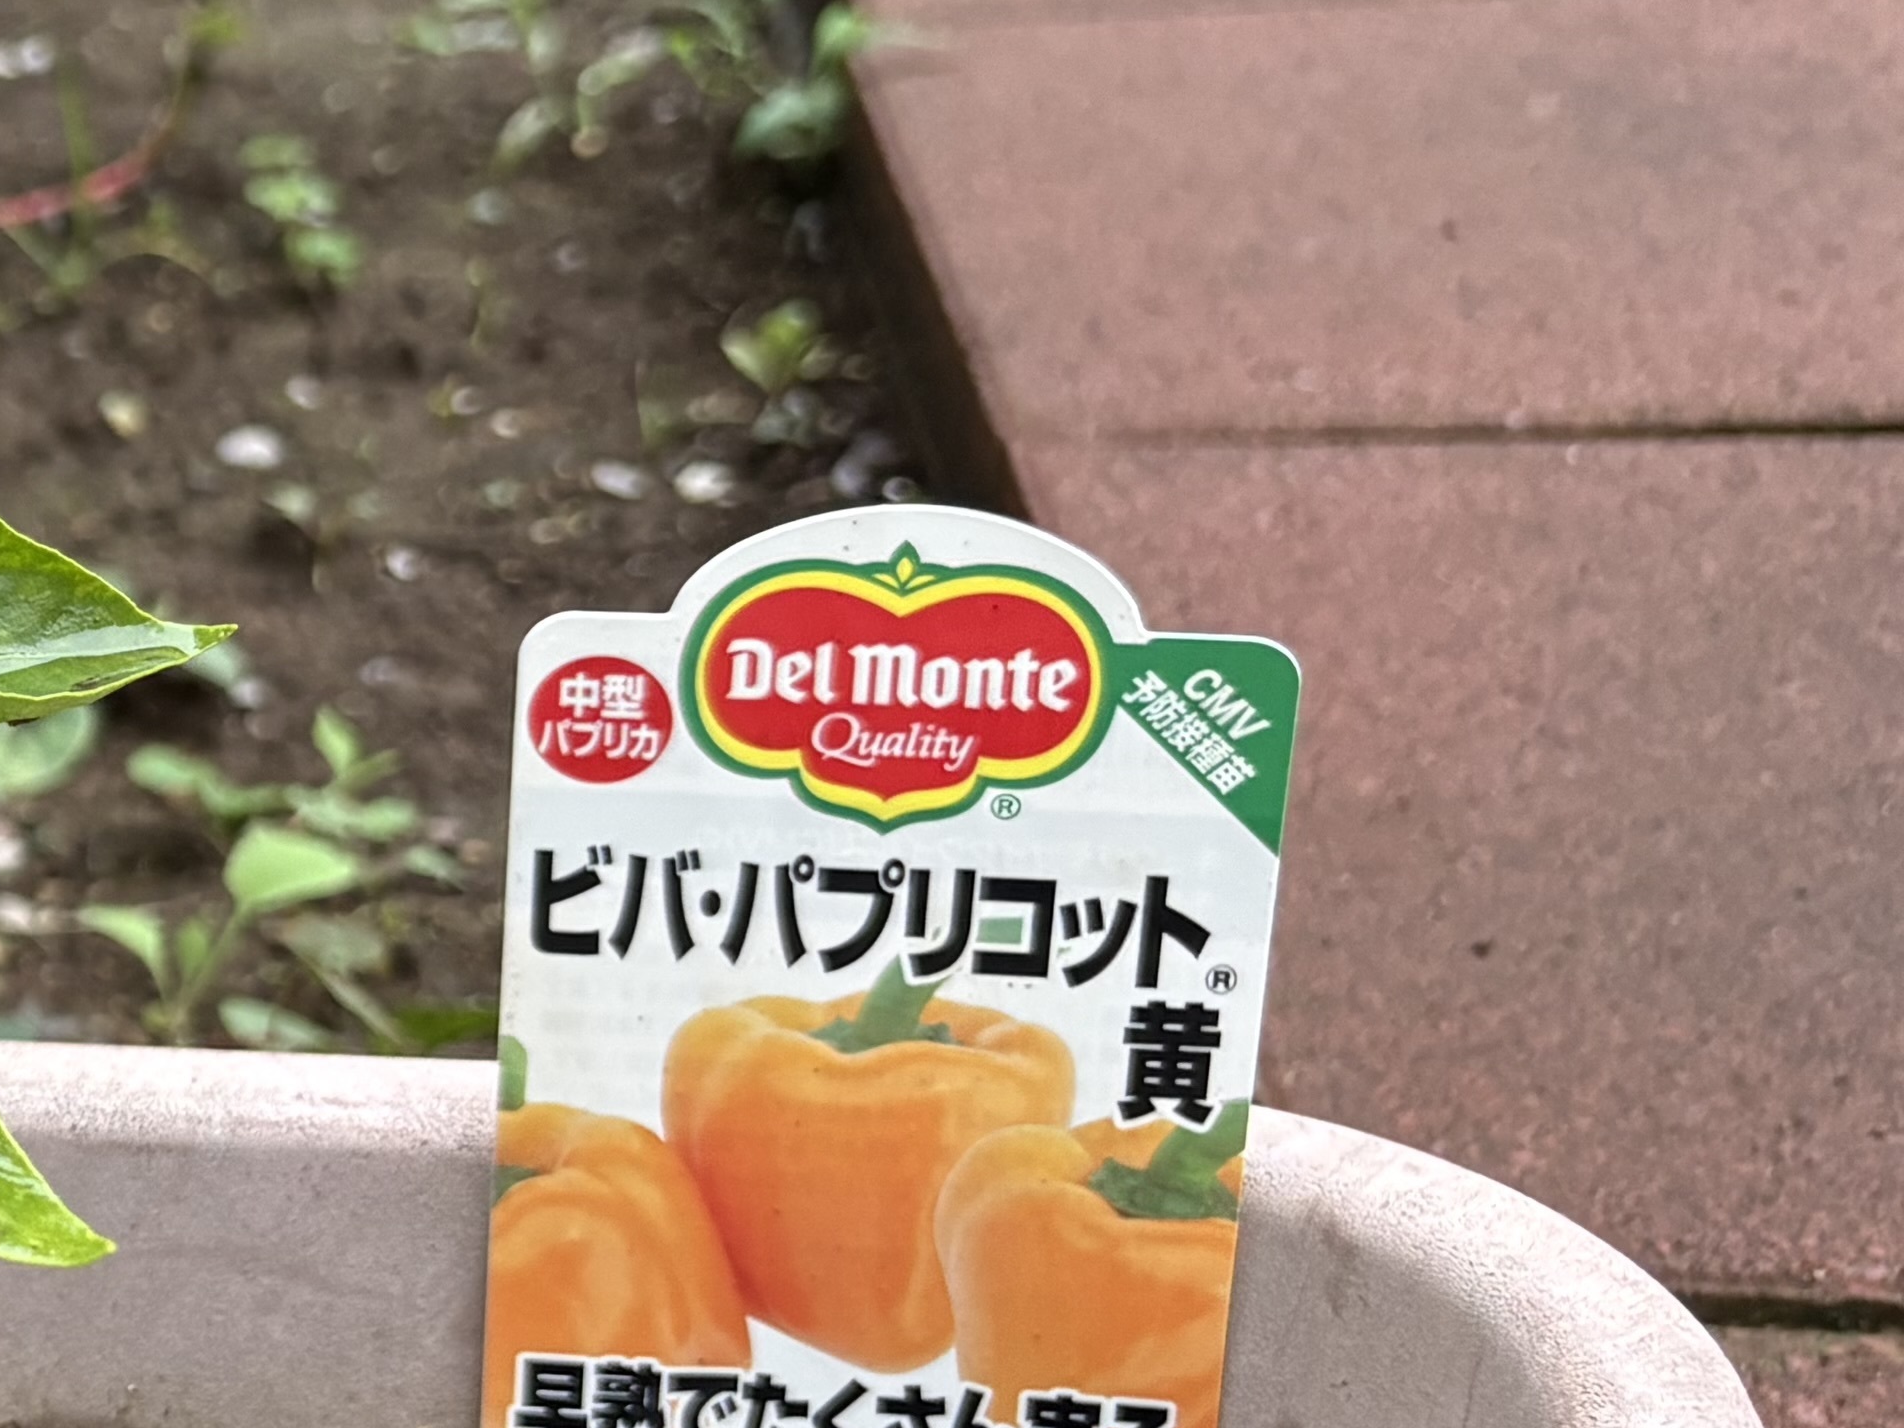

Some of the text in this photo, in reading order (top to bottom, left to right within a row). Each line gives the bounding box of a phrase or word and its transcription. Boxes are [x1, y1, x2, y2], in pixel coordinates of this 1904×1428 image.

[558, 672, 647, 720] 中型
[727, 638, 1079, 711] Del Monte
[1184, 669, 1272, 740] CMV
[538, 720, 661, 761] パプリカ
[811, 711, 976, 772] Quality
[1121, 670, 1256, 795] 予防接種苗
[530, 845, 1211, 989] ビバ・パプリコット
[1117, 1000, 1222, 1126] 黄
